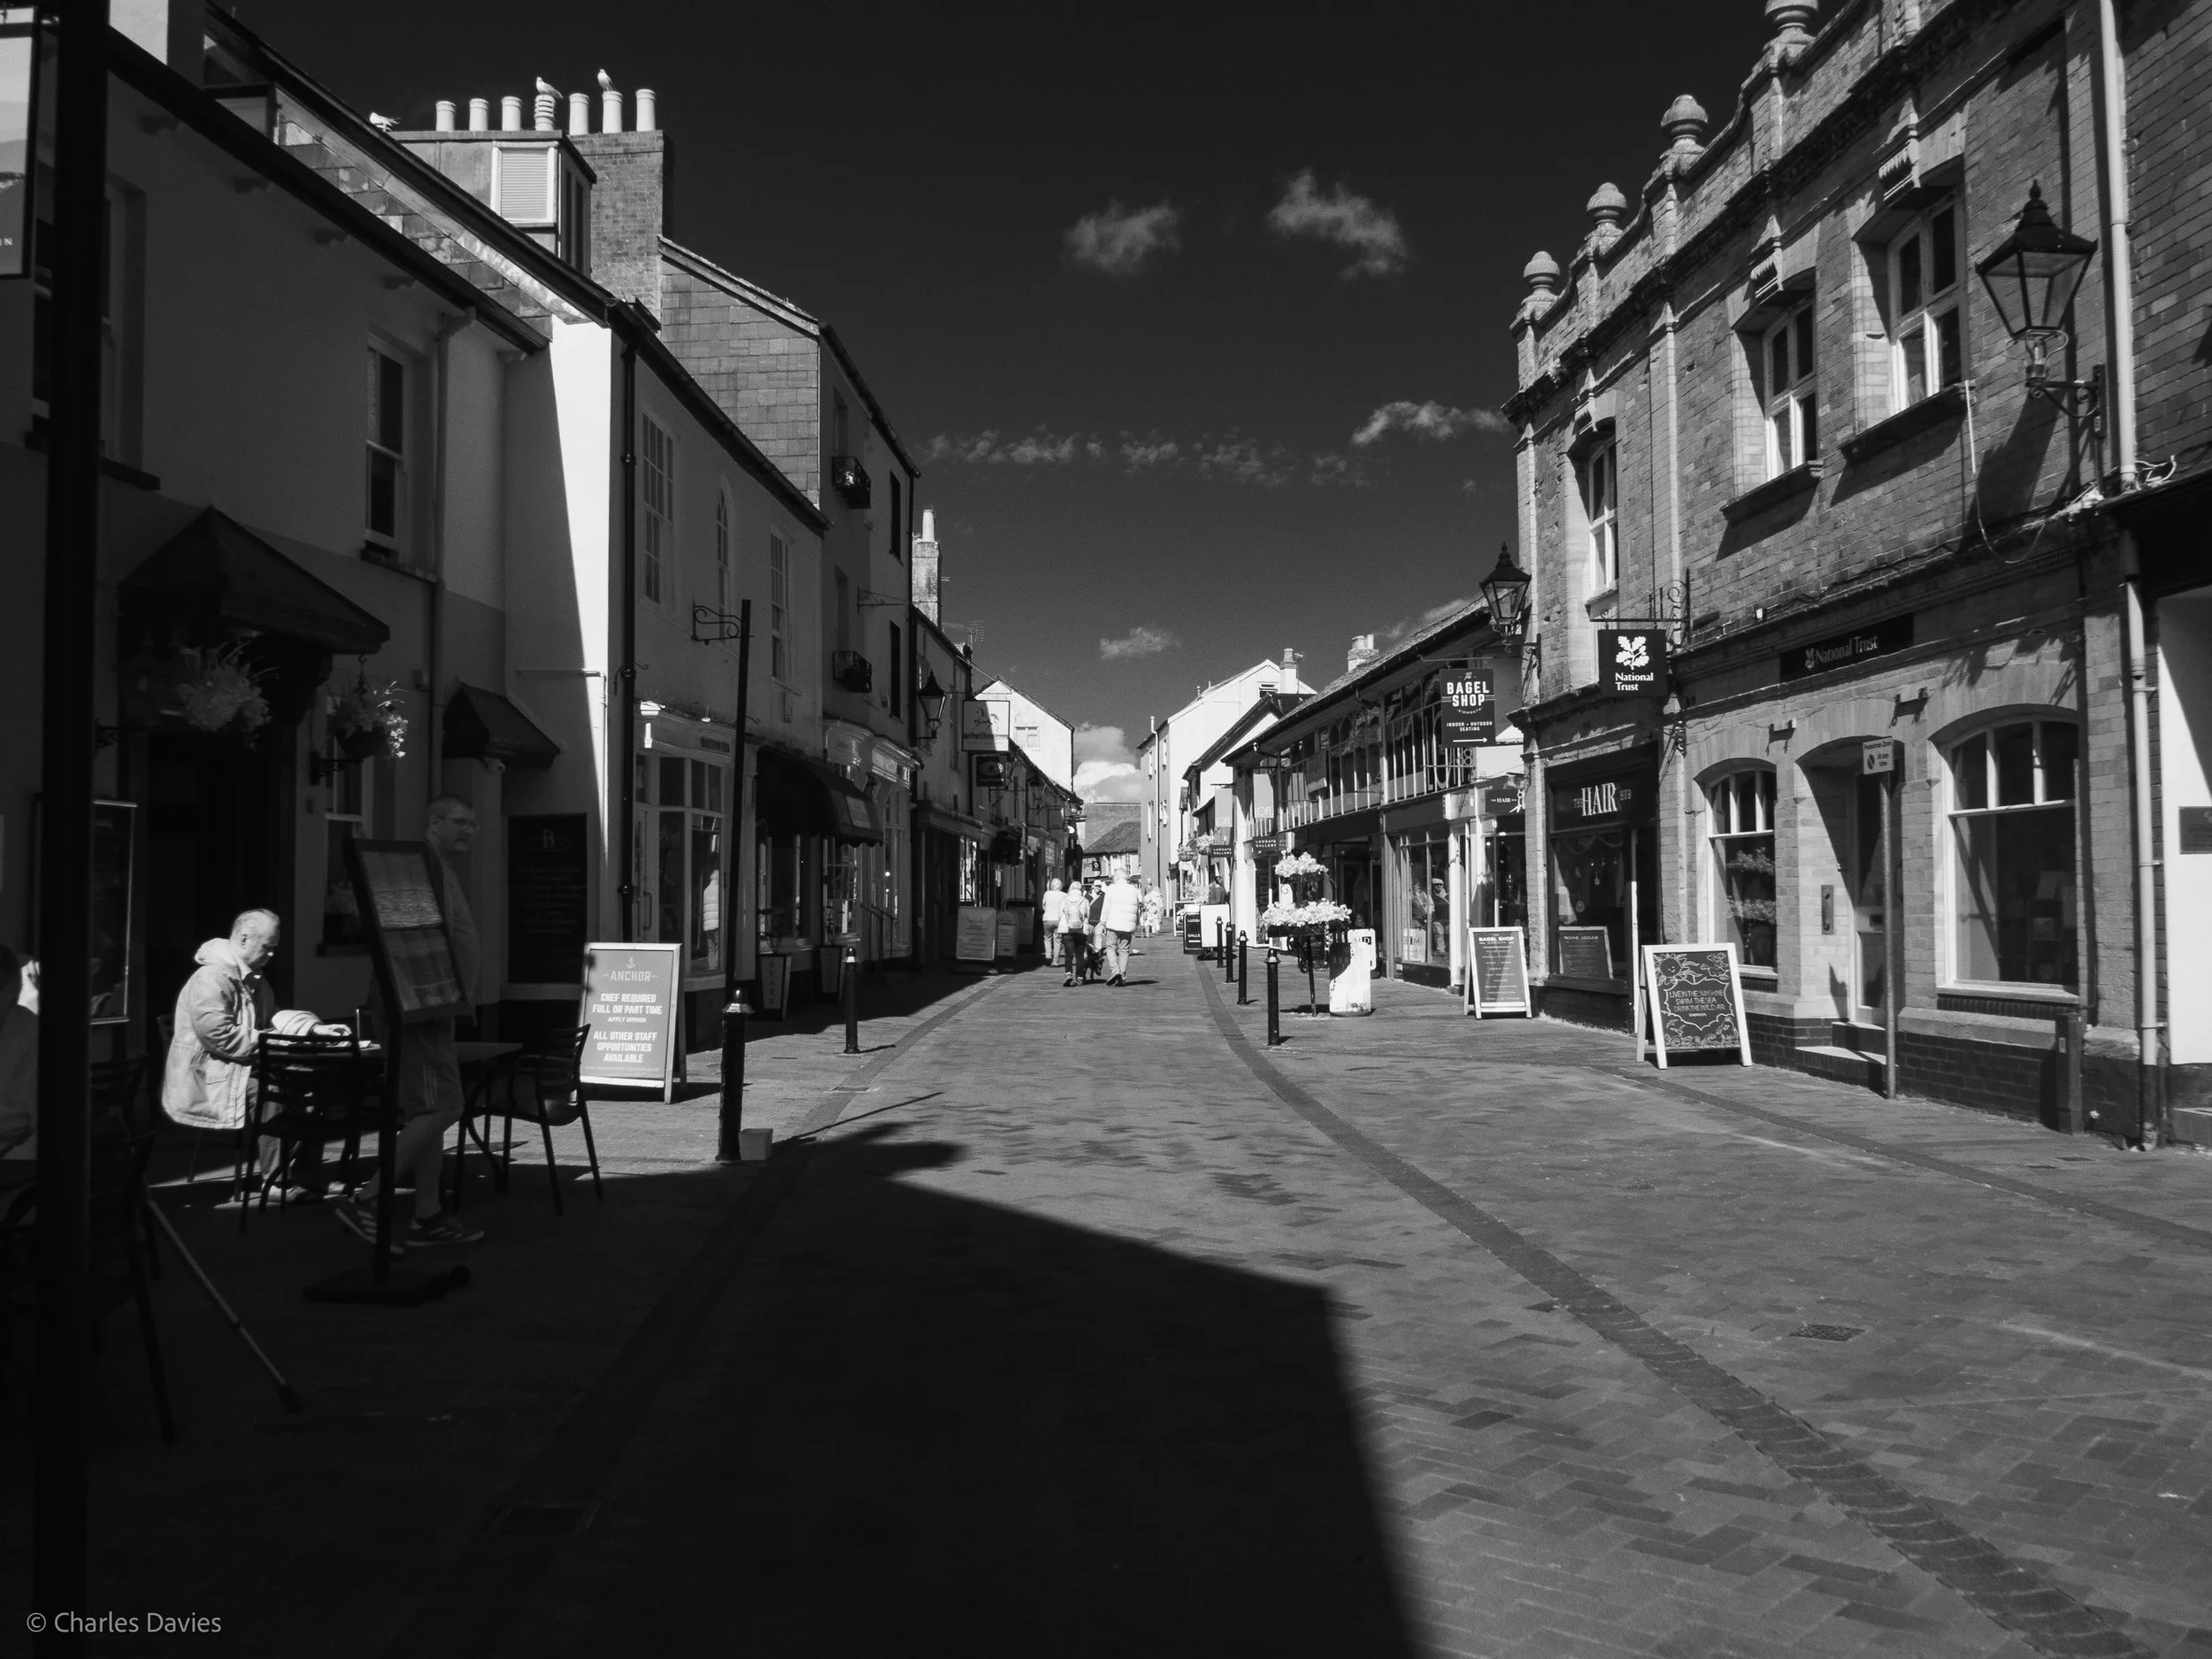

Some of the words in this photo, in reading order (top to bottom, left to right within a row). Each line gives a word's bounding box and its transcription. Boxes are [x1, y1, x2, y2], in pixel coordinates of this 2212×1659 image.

[1815, 638, 1853, 664] National
[1853, 635, 1878, 654] Trust
[1615, 672, 1654, 681] National
[1446, 680, 1490, 695] BAGEL
[1615, 681, 1639, 691] Trust
[1452, 694, 1486, 707] SHOP
[1581, 782, 1617, 817] HAIR
[610, 970, 651, 982] ANCHOR
[601, 993, 620, 1002] CHEF
[621, 993, 657, 1004] REQUIRED
[592, 1004, 611, 1014] FULL
[612, 1005, 624, 1014] OR
[624, 1005, 644, 1015] PART
[646, 1005, 663, 1015] TIME
[593, 1030, 609, 1041] ALL
[610, 1031, 634, 1041] OTHER
[634, 1032, 658, 1041] STAFF
[597, 1042, 652, 1052] OPPORTUNITIES
[603, 1053, 644, 1064] AVAILABLE
